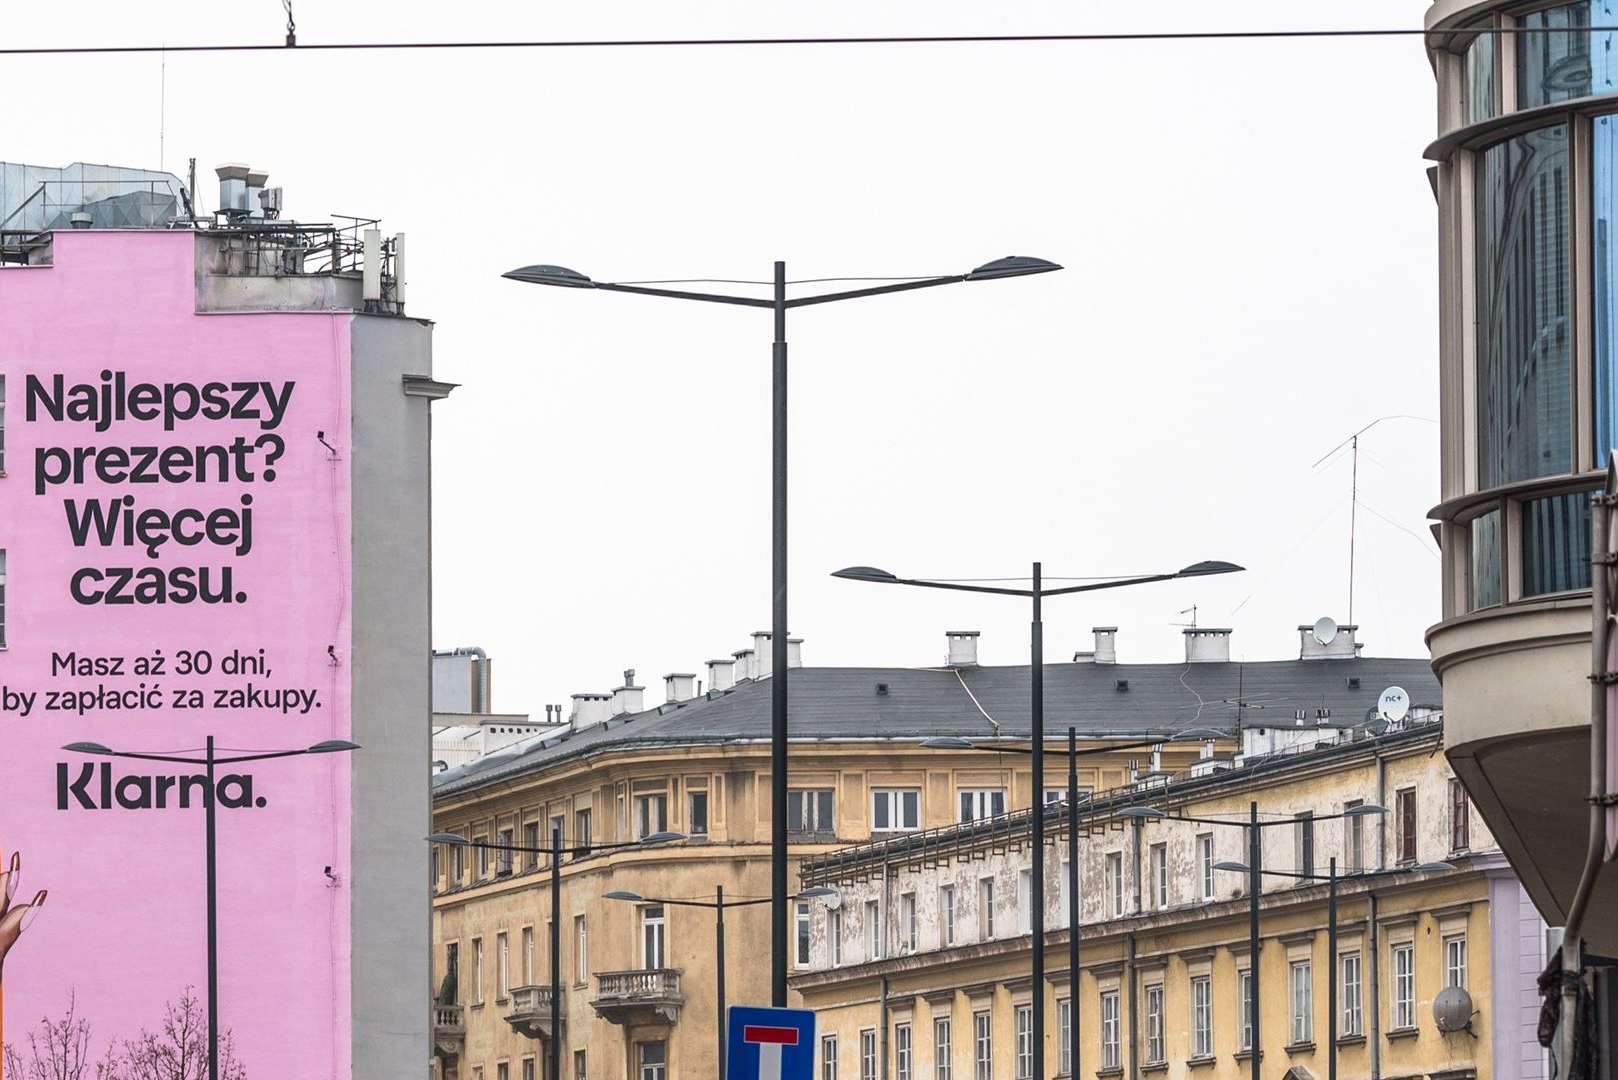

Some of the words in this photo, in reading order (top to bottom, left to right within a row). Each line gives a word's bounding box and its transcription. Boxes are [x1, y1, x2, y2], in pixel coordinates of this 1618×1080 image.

[25, 369, 295, 432] Najlepszy
[34, 434, 286, 496] prezent?
[63, 494, 254, 559] Więcej
[69, 566, 248, 606] czasu.
[51, 651, 125, 677] Masz
[133, 649, 166, 677] aż
[174, 650, 213, 676] 30
[221, 648, 272, 679] dni,
[2, 685, 37, 717] by
[45, 682, 163, 716] zapłacić
[172, 689, 204, 710] za
[213, 682, 322, 715] zakupy.
[56, 761, 267, 811] Klarna.
